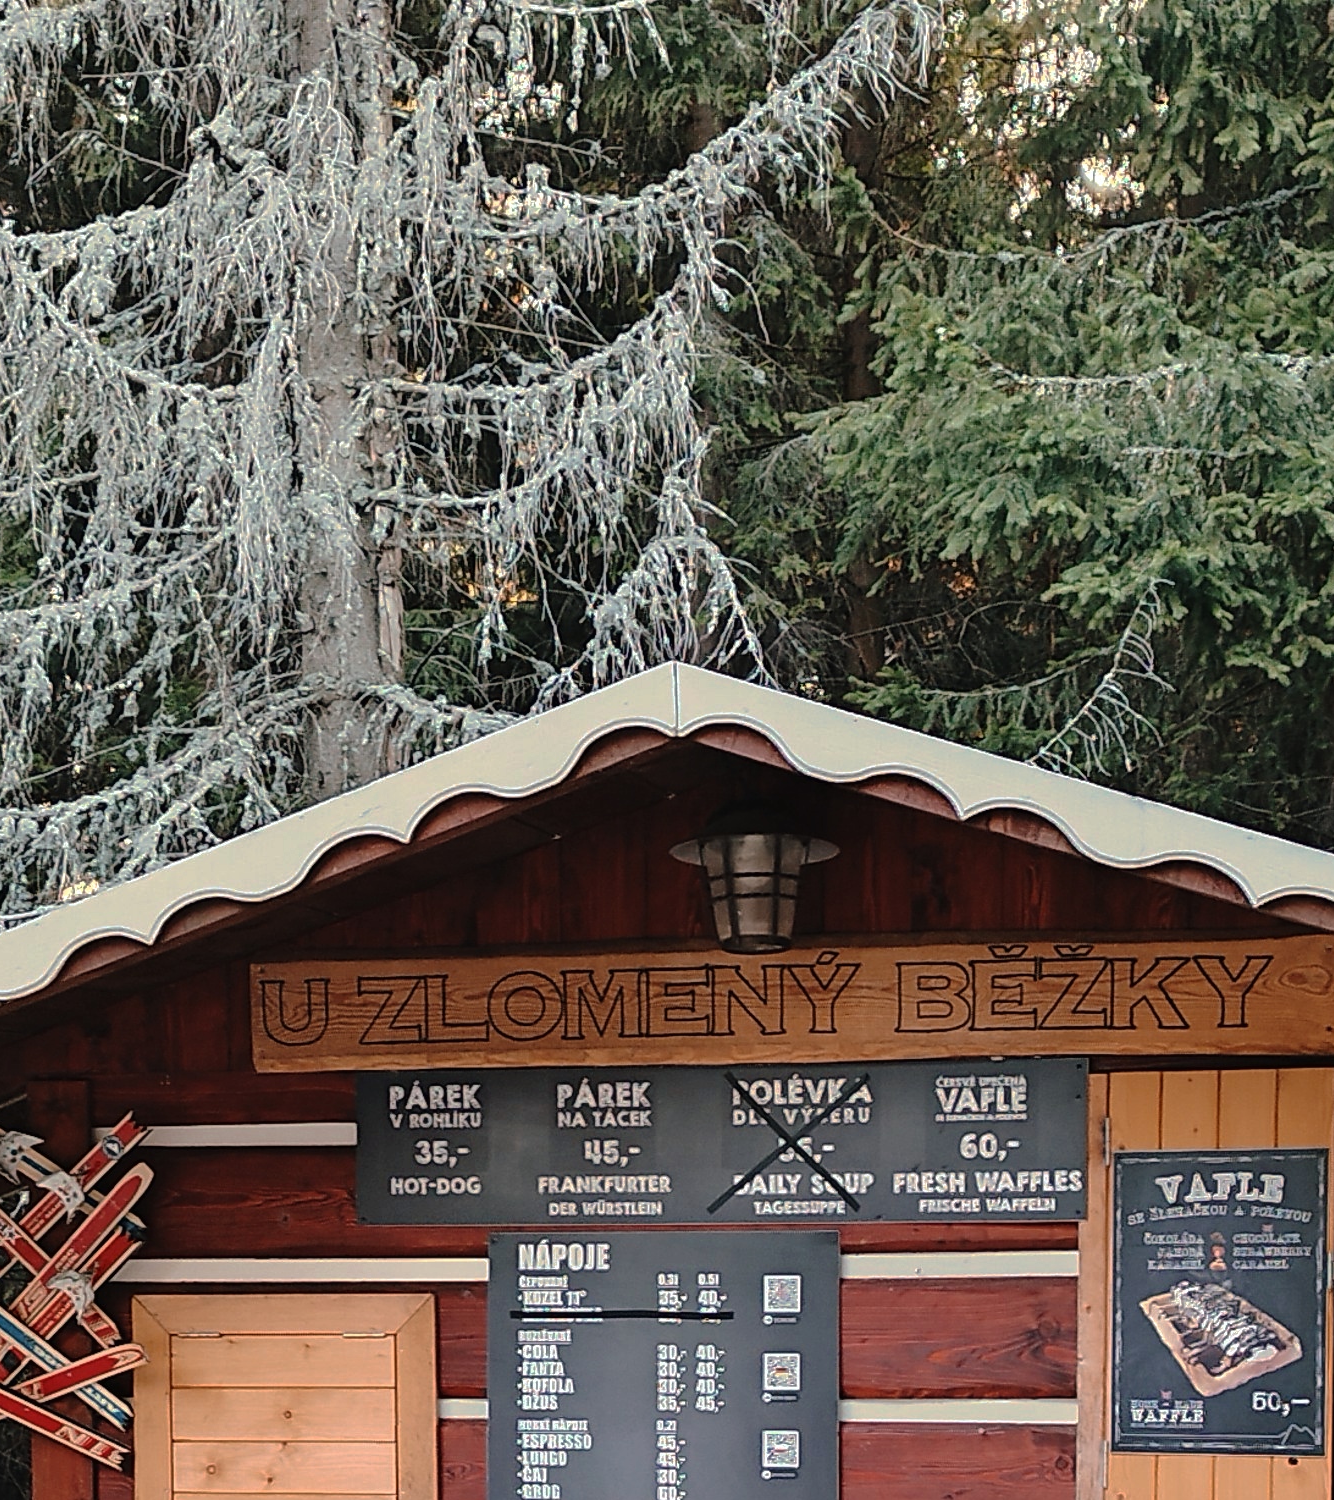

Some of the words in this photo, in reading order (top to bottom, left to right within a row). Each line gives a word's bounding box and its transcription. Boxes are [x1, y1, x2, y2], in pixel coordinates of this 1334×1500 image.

[259, 977, 332, 1046] U
[357, 950, 862, 1045] ZLOMENÝ
[895, 945, 1274, 1033] BĚŽKY
[388, 1079, 482, 1110] PÁREK
[556, 1076, 651, 1109] PÁREK
[934, 1086, 1028, 1113] VAFLE
[389, 1112, 402, 1129] V
[408, 1109, 482, 1129] ROHLÍKU
[557, 1111, 588, 1128] NA
[592, 1108, 652, 1128] TÁCEK
[414, 1139, 471, 1169] 35,-
[583, 1138, 642, 1168] 45,-
[959, 1132, 1021, 1161] 60,-
[390, 1175, 482, 1195] HOT-DOG
[537, 1174, 673, 1194] FRANKFURTER
[732, 1173, 803, 1196] DAILY
[892, 1171, 966, 1194] FRESH
[974, 1169, 1083, 1193] WAFFLES
[1153, 1171, 1285, 1205] VAFLE
[548, 1200, 578, 1216] DER
[581, 1199, 663, 1216] WÜRSTLEIN
[753, 1200, 847, 1215] TAGESSUPPE
[918, 1197, 982, 1213] FRISCHE
[985, 1196, 1057, 1213] WAFFELN
[518, 1238, 611, 1271] NÁPOJE
[522, 1344, 558, 1360] COLA
[522, 1360, 565, 1376] FANTA
[522, 1377, 575, 1394] KOFOLA
[1130, 1409, 1204, 1423] WAFFLE
[522, 1433, 593, 1450] ESPRESSO
[522, 1450, 568, 1467] LUNGO
[522, 1465, 547, 1483] ČAJ
[522, 1483, 561, 1500] GROG
